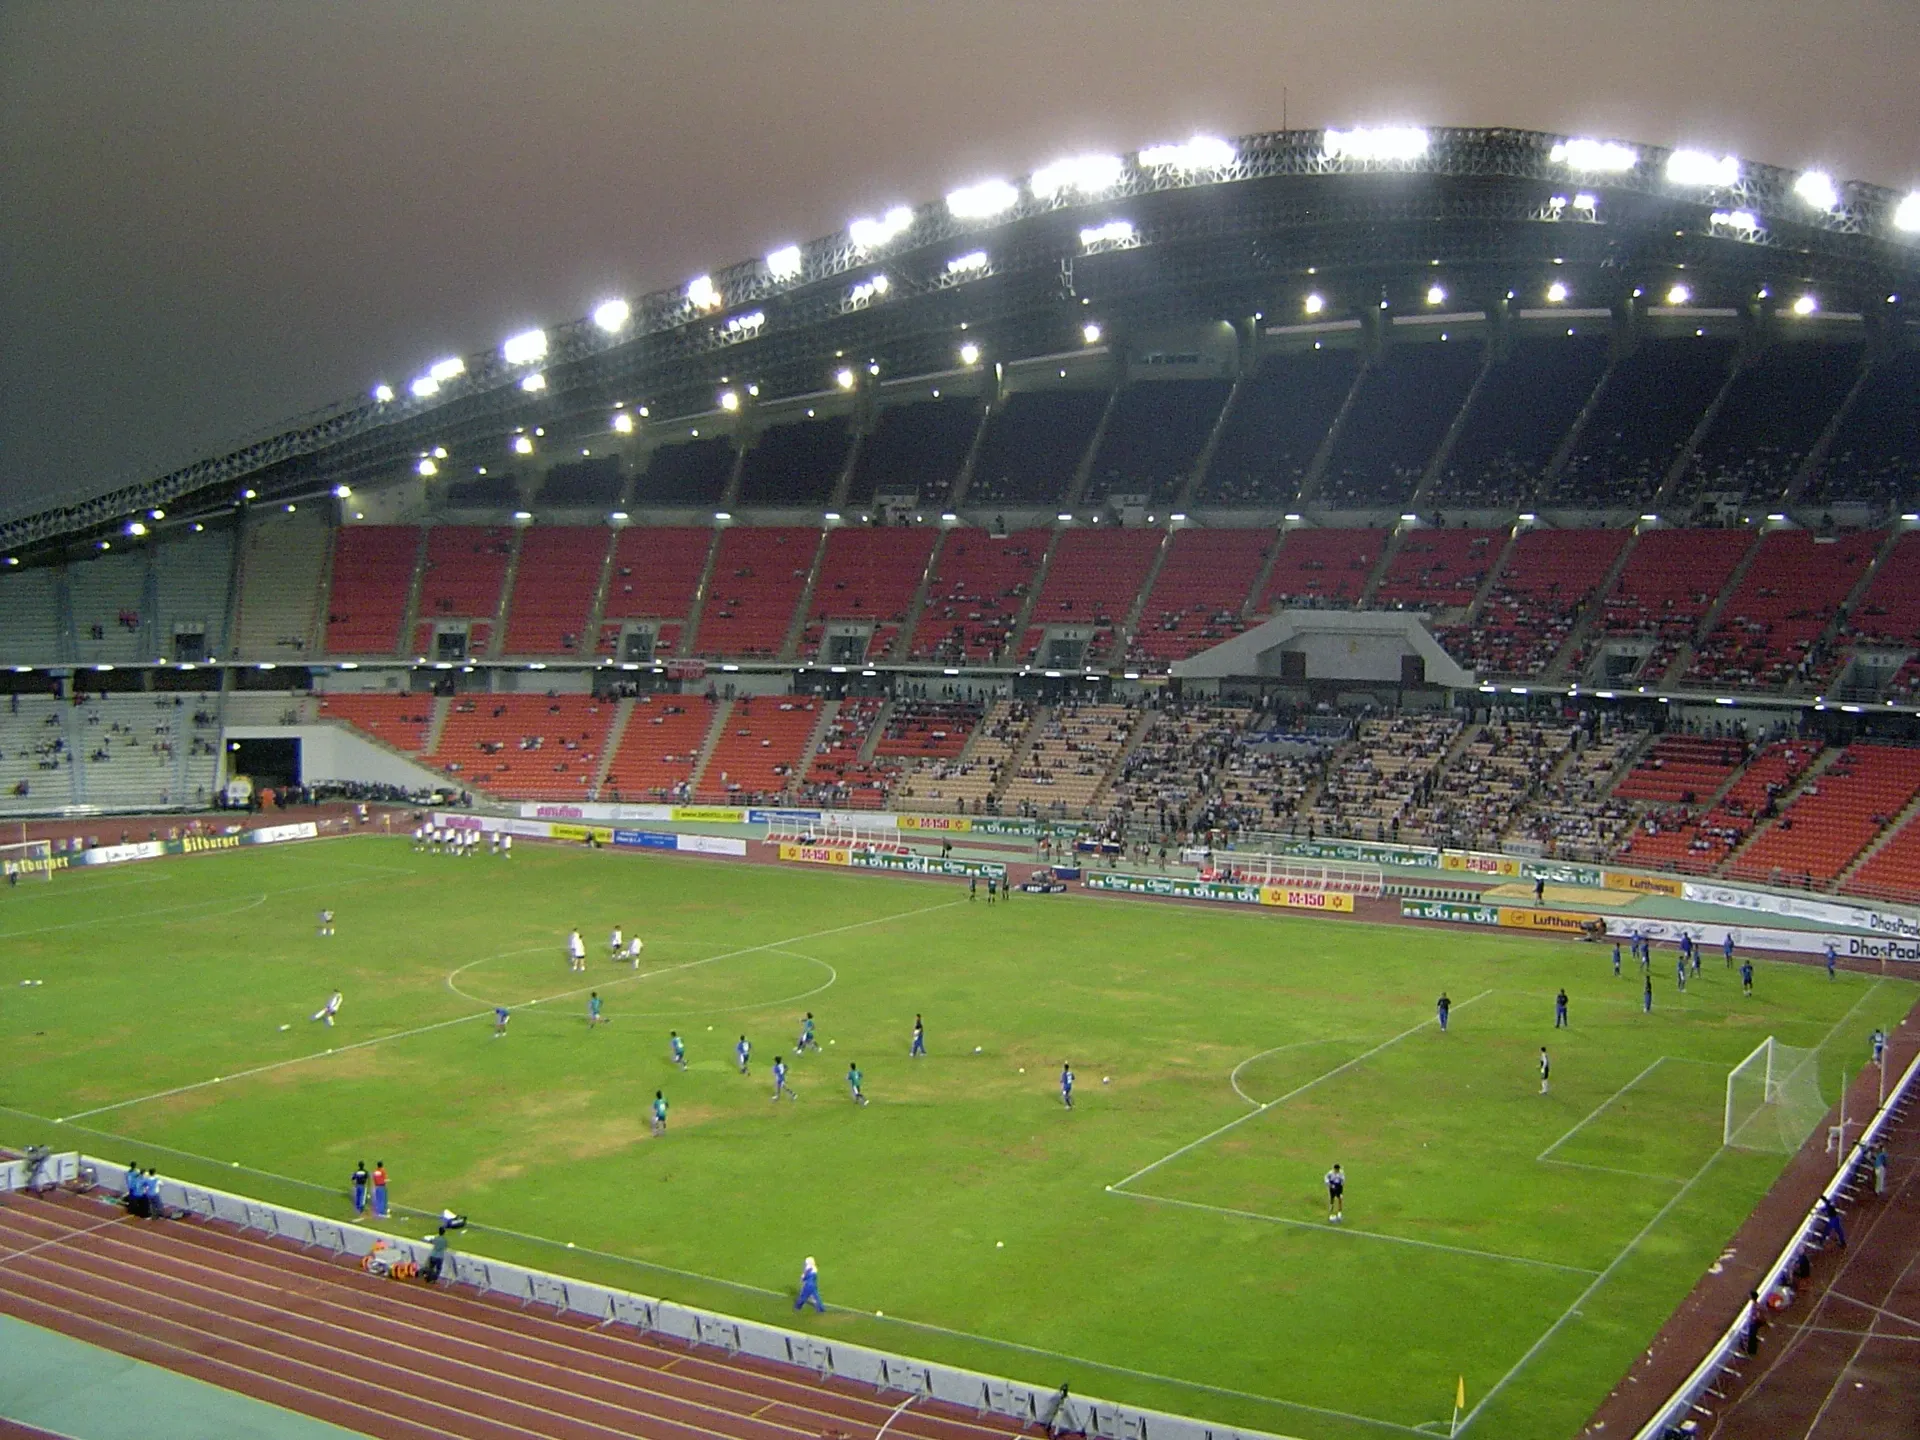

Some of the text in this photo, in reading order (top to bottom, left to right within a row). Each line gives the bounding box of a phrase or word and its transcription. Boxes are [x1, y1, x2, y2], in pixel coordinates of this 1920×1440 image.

[920, 818, 950, 829] M-150
[183, 836, 240, 853] Bitburger
[802, 848, 830, 861] M-150
[1288, 891, 1325, 906] M-150
